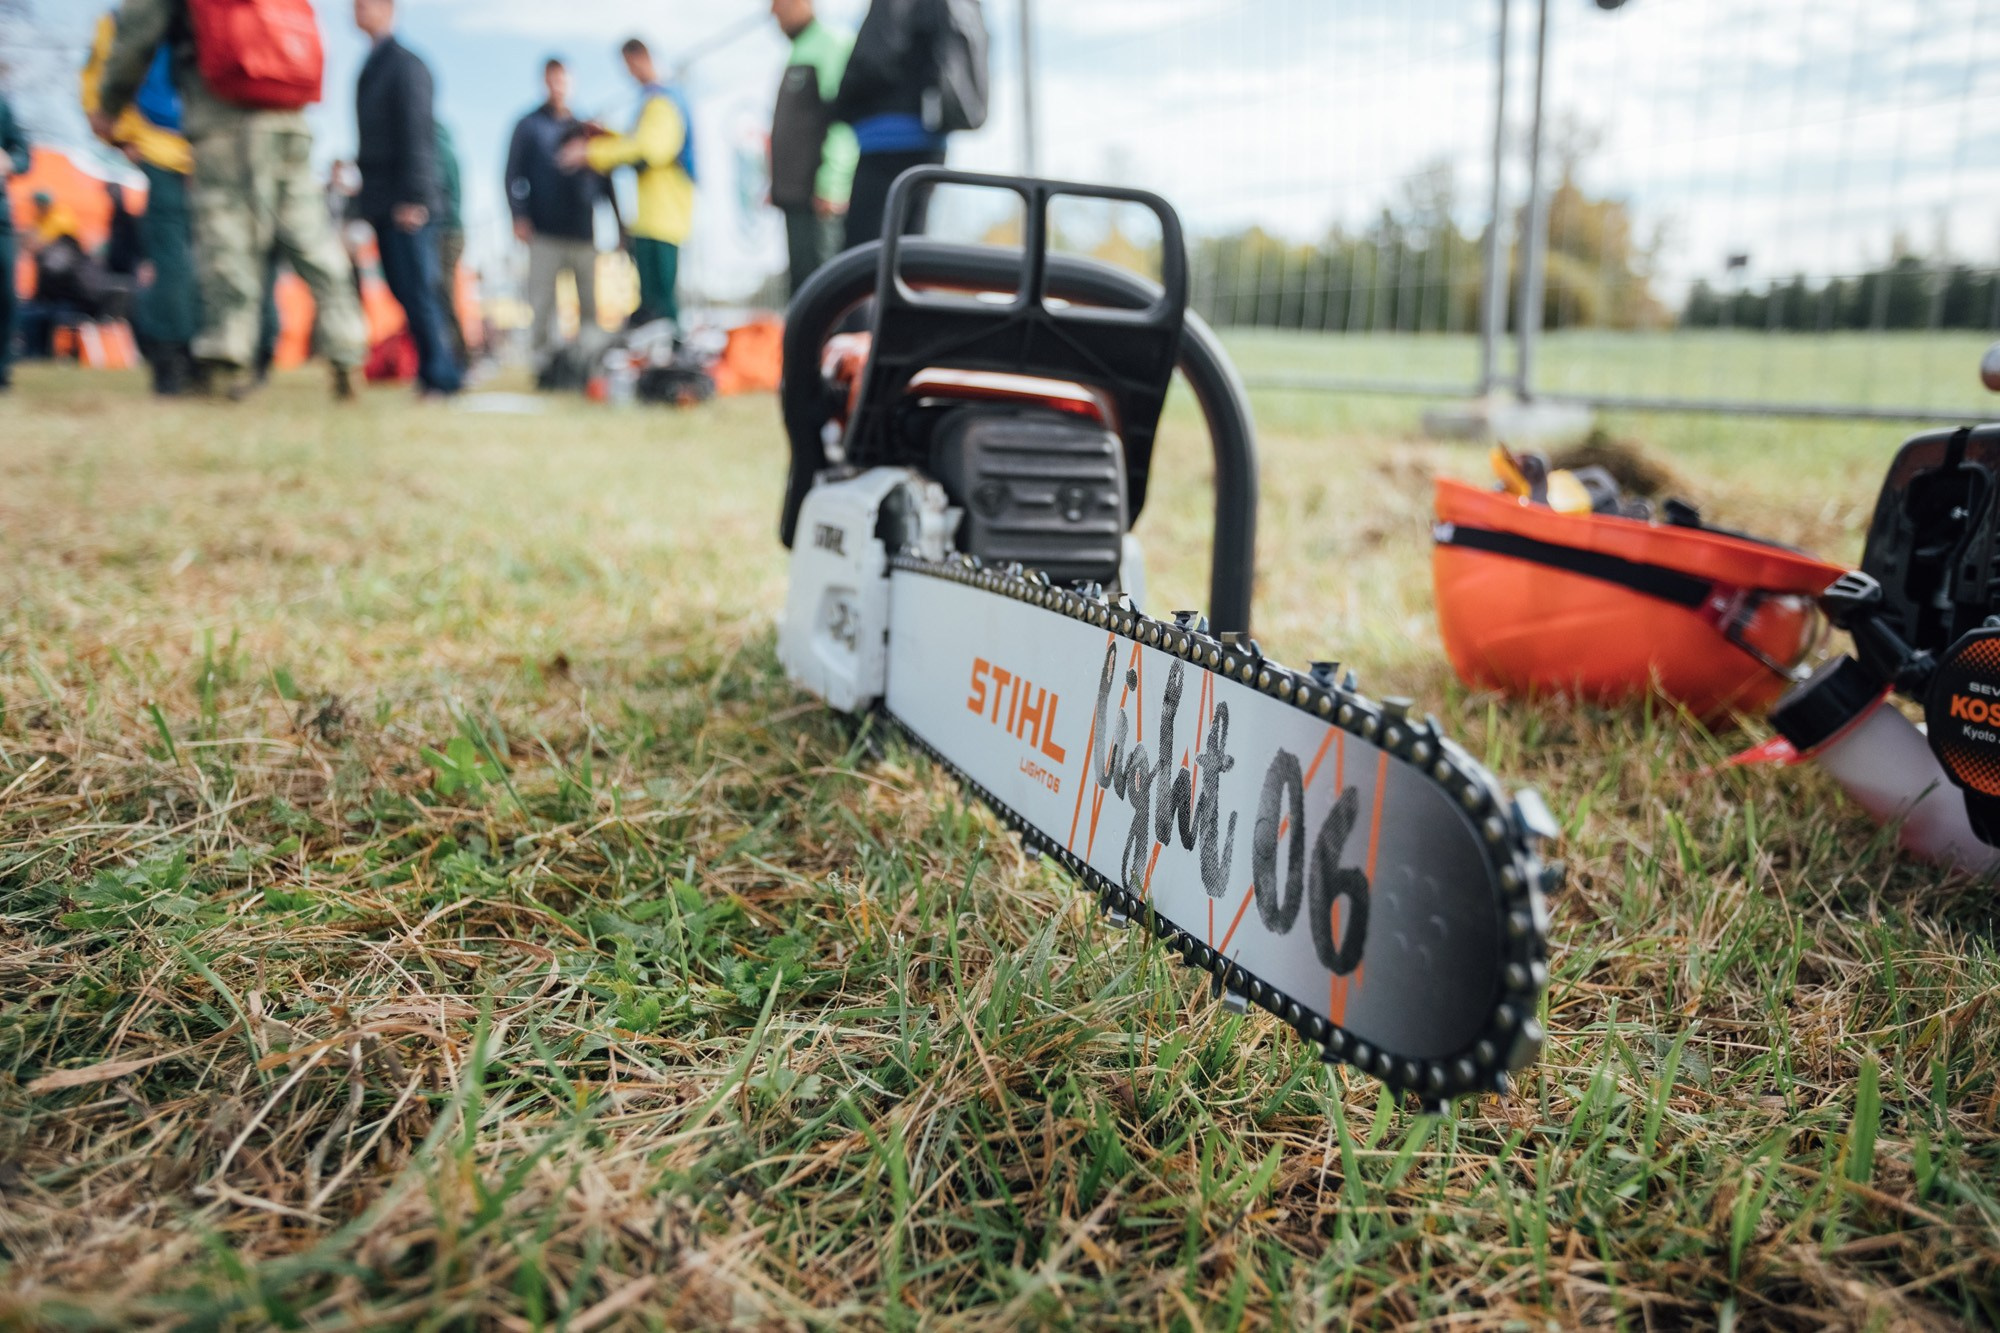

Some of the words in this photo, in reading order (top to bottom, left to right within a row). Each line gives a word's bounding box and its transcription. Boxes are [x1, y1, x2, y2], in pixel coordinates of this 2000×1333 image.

[967, 657, 1066, 765] STIHL
[1951, 694, 2000, 728] KOS
[1963, 724, 1997, 743] Kyoto
[1019, 756, 1047, 784] LIGHT
[1046, 773, 1061, 794] 06
[1093, 640, 1238, 900] Light
[1252, 747, 1370, 976] 06
